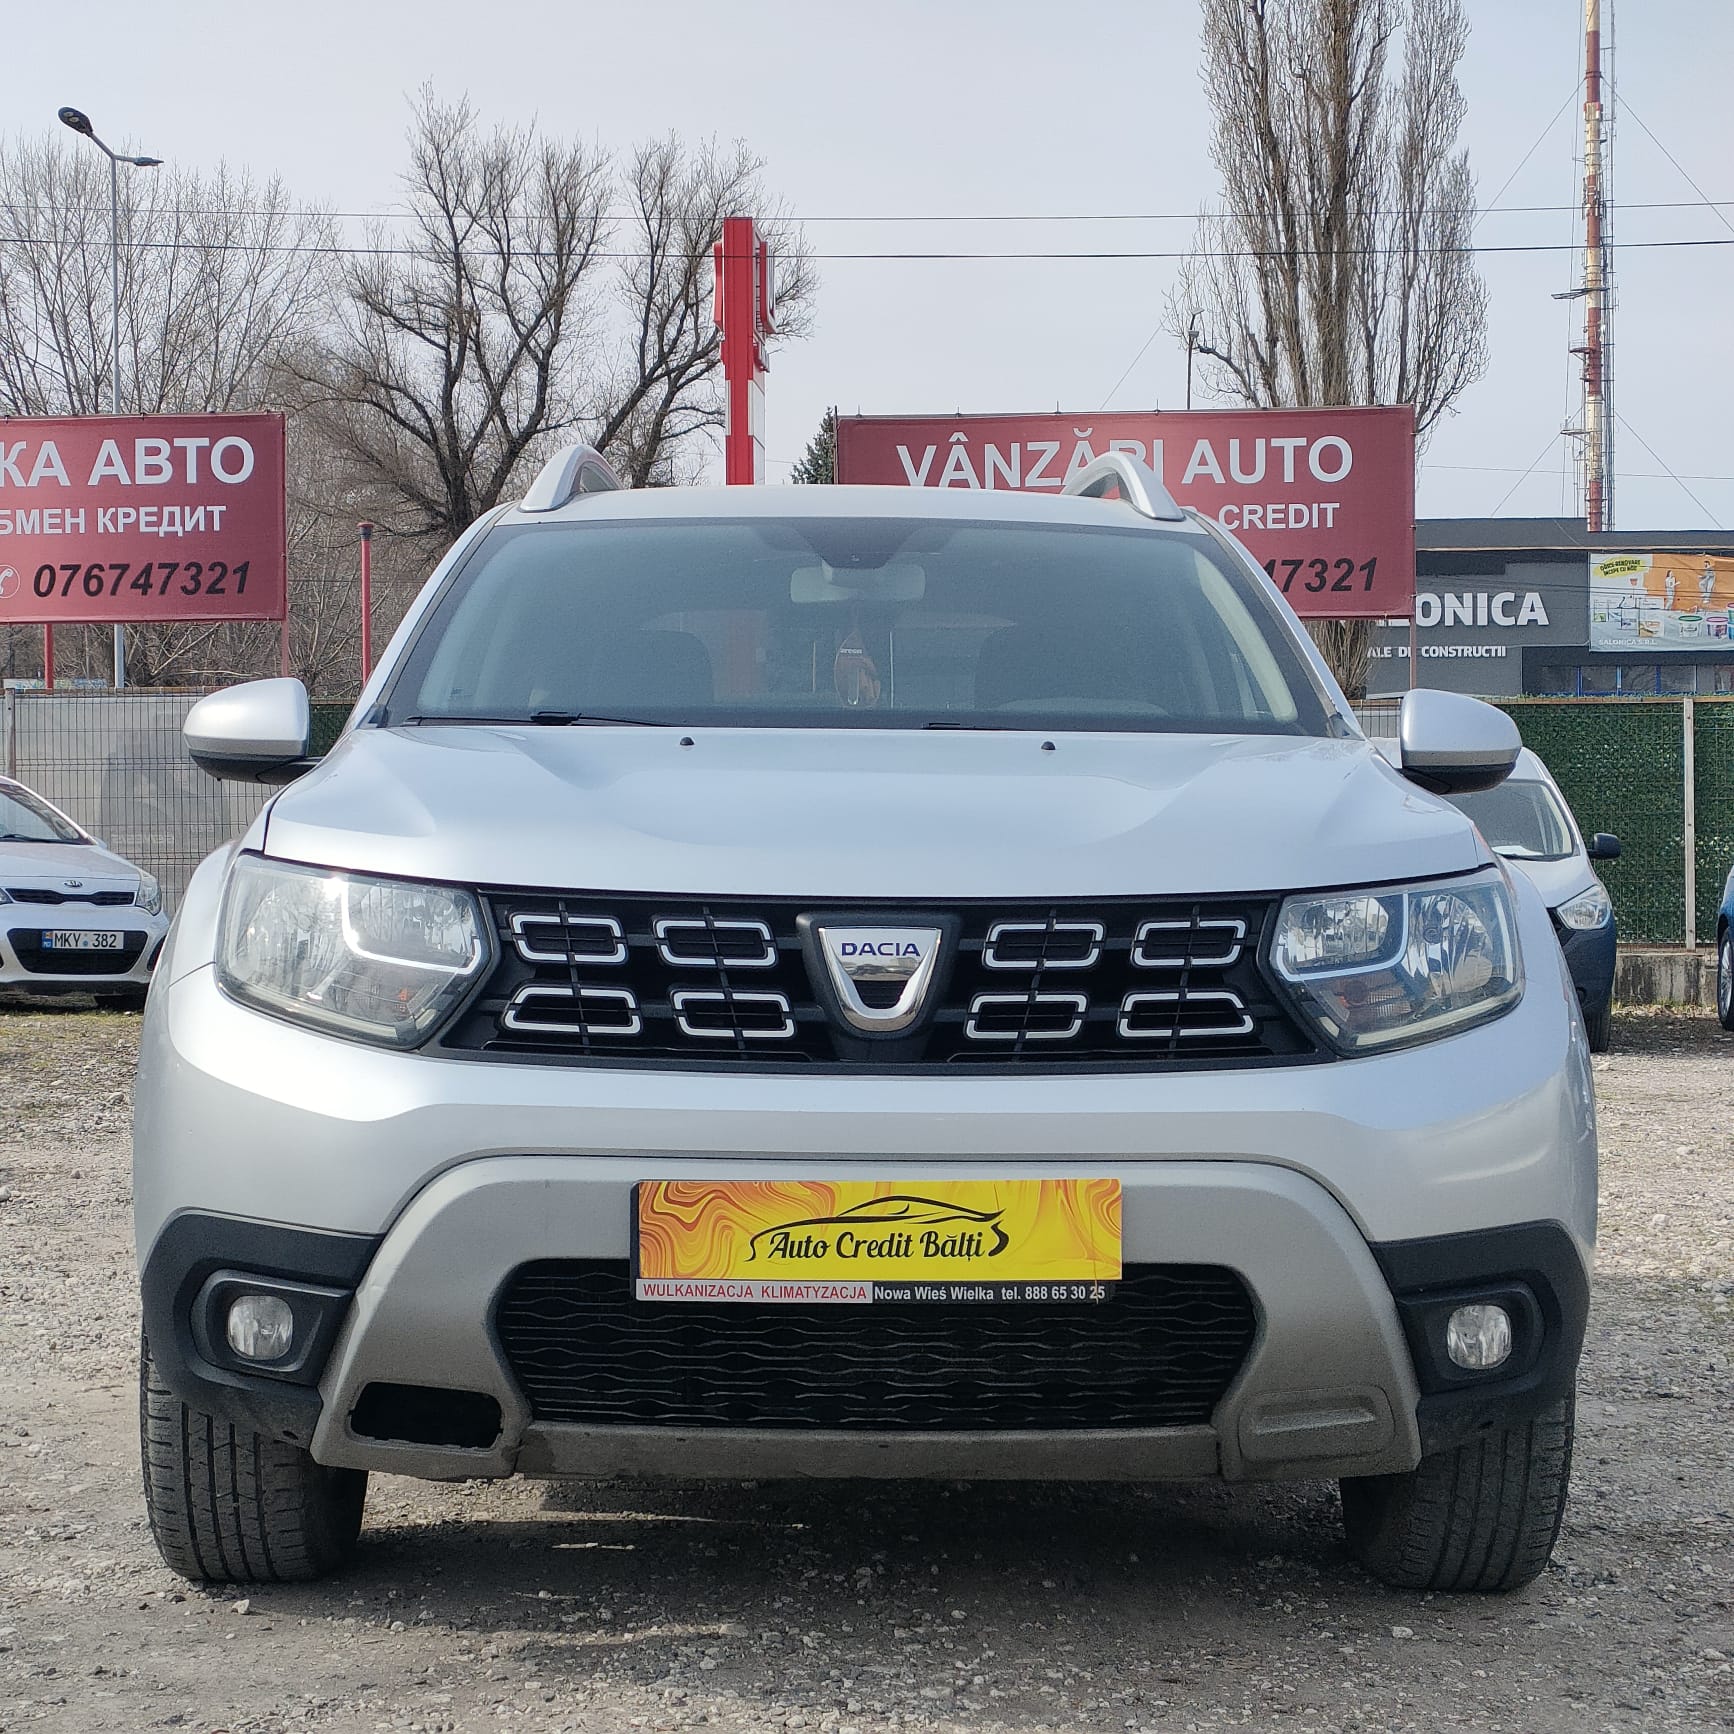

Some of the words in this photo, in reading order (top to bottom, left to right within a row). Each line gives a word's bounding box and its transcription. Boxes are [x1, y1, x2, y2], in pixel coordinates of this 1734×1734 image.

[0, 440, 71, 487] КА
[88, 436, 255, 485] АВТО
[1181, 435, 1353, 484] AUTO
[0, 508, 86, 535] БМЕН
[97, 505, 227, 537] КРЕДИТ
[1218, 503, 1340, 530] CREDIT
[33, 560, 251, 598] 076747321
[1376, 592, 1550, 627] ONICA
[1421, 645, 1507, 658] CONSTRUCTII
[54, 932, 81, 948] MKY
[92, 933, 117, 949] 382
[841, 942, 921, 957] DACIA
[768, 1231, 831, 1259] Auto
[836, 1231, 914, 1259] Credit
[643, 1283, 754, 1298] WULKANIZACJA
[761, 1285, 867, 1300] KLIMATYZACJA
[874, 1286, 911, 1300] Nowa
[915, 1285, 947, 1300] Wieś
[951, 1286, 994, 1300] Wielka
[1001, 1286, 1021, 1300] tel.
[1025, 1286, 1048, 1300] 888
[1052, 1286, 1067, 1300] 65
[1071, 1286, 1086, 1299] 30
[1090, 1285, 1105, 1299] 25
